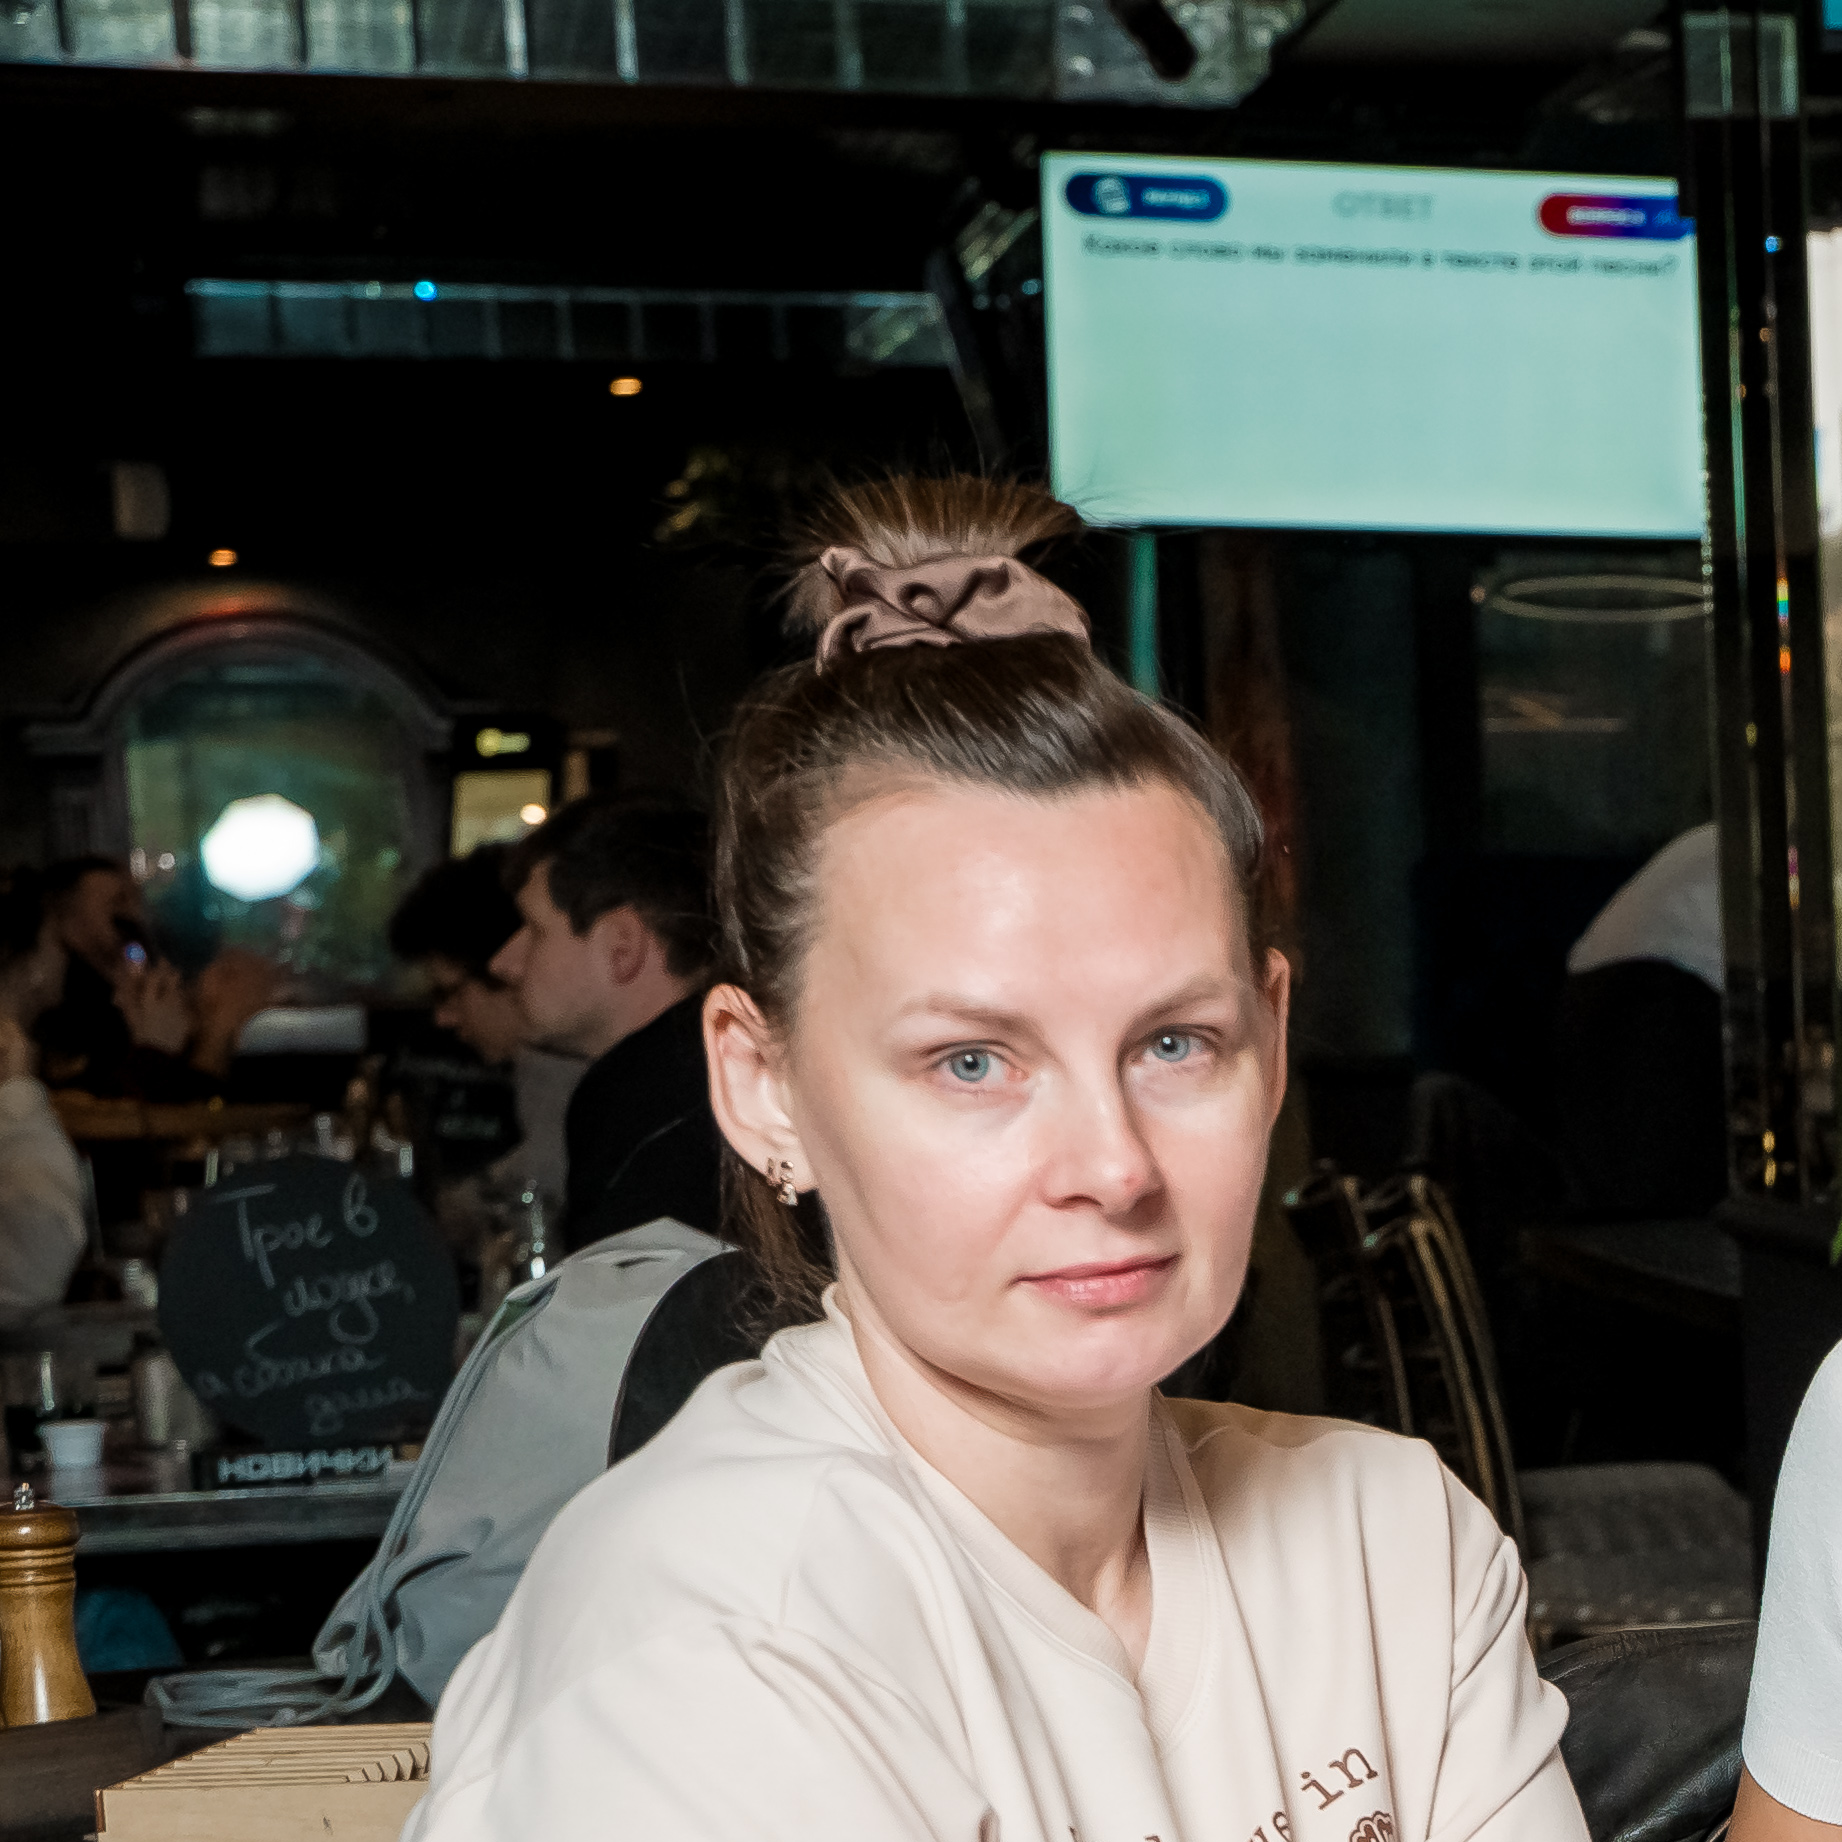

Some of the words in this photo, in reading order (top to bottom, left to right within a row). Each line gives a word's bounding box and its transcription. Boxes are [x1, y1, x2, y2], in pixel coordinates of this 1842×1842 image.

[1332, 191, 1434, 218] ОТВЕТ
[206, 1182, 333, 1289] Трое
[342, 1172, 379, 1238] в
